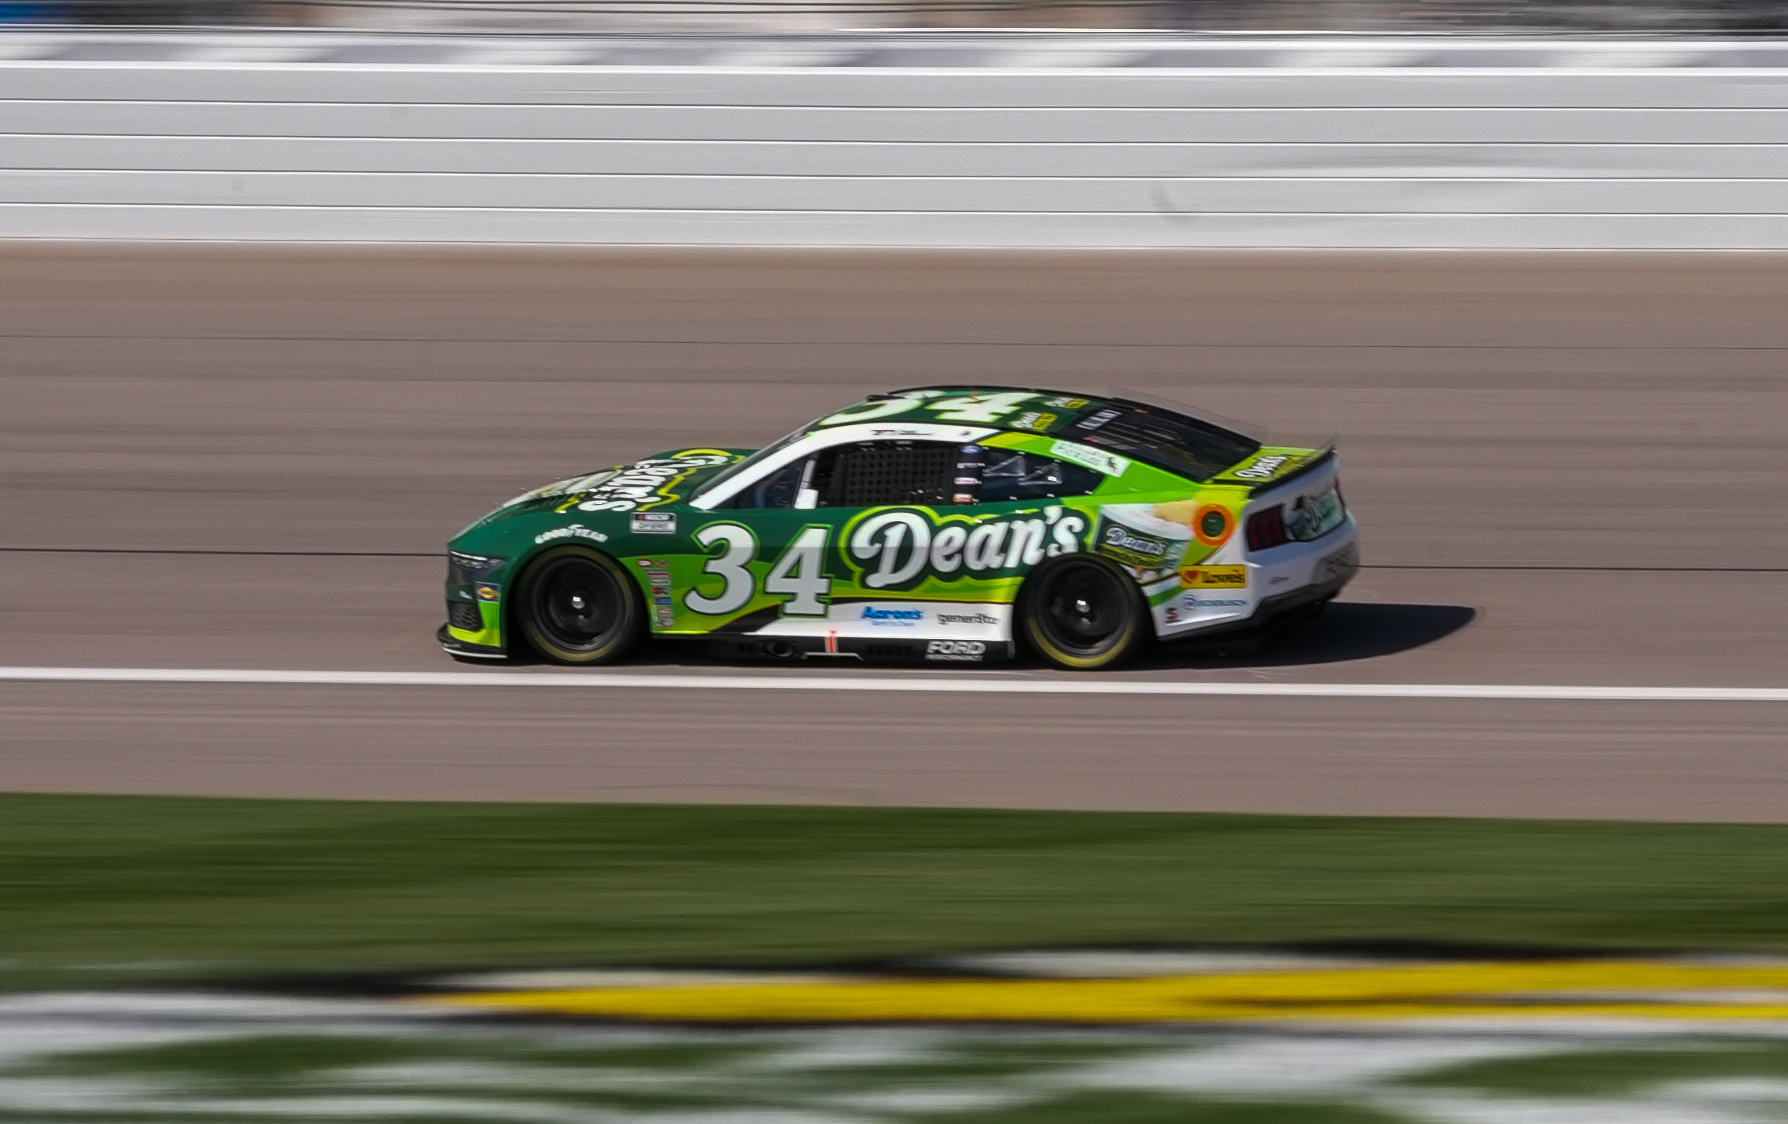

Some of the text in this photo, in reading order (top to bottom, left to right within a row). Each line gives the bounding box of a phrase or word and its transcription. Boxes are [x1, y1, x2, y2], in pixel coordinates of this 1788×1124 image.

[684, 523, 831, 615] 34
[851, 505, 1085, 588] Dean's
[927, 640, 987, 655] FORD
